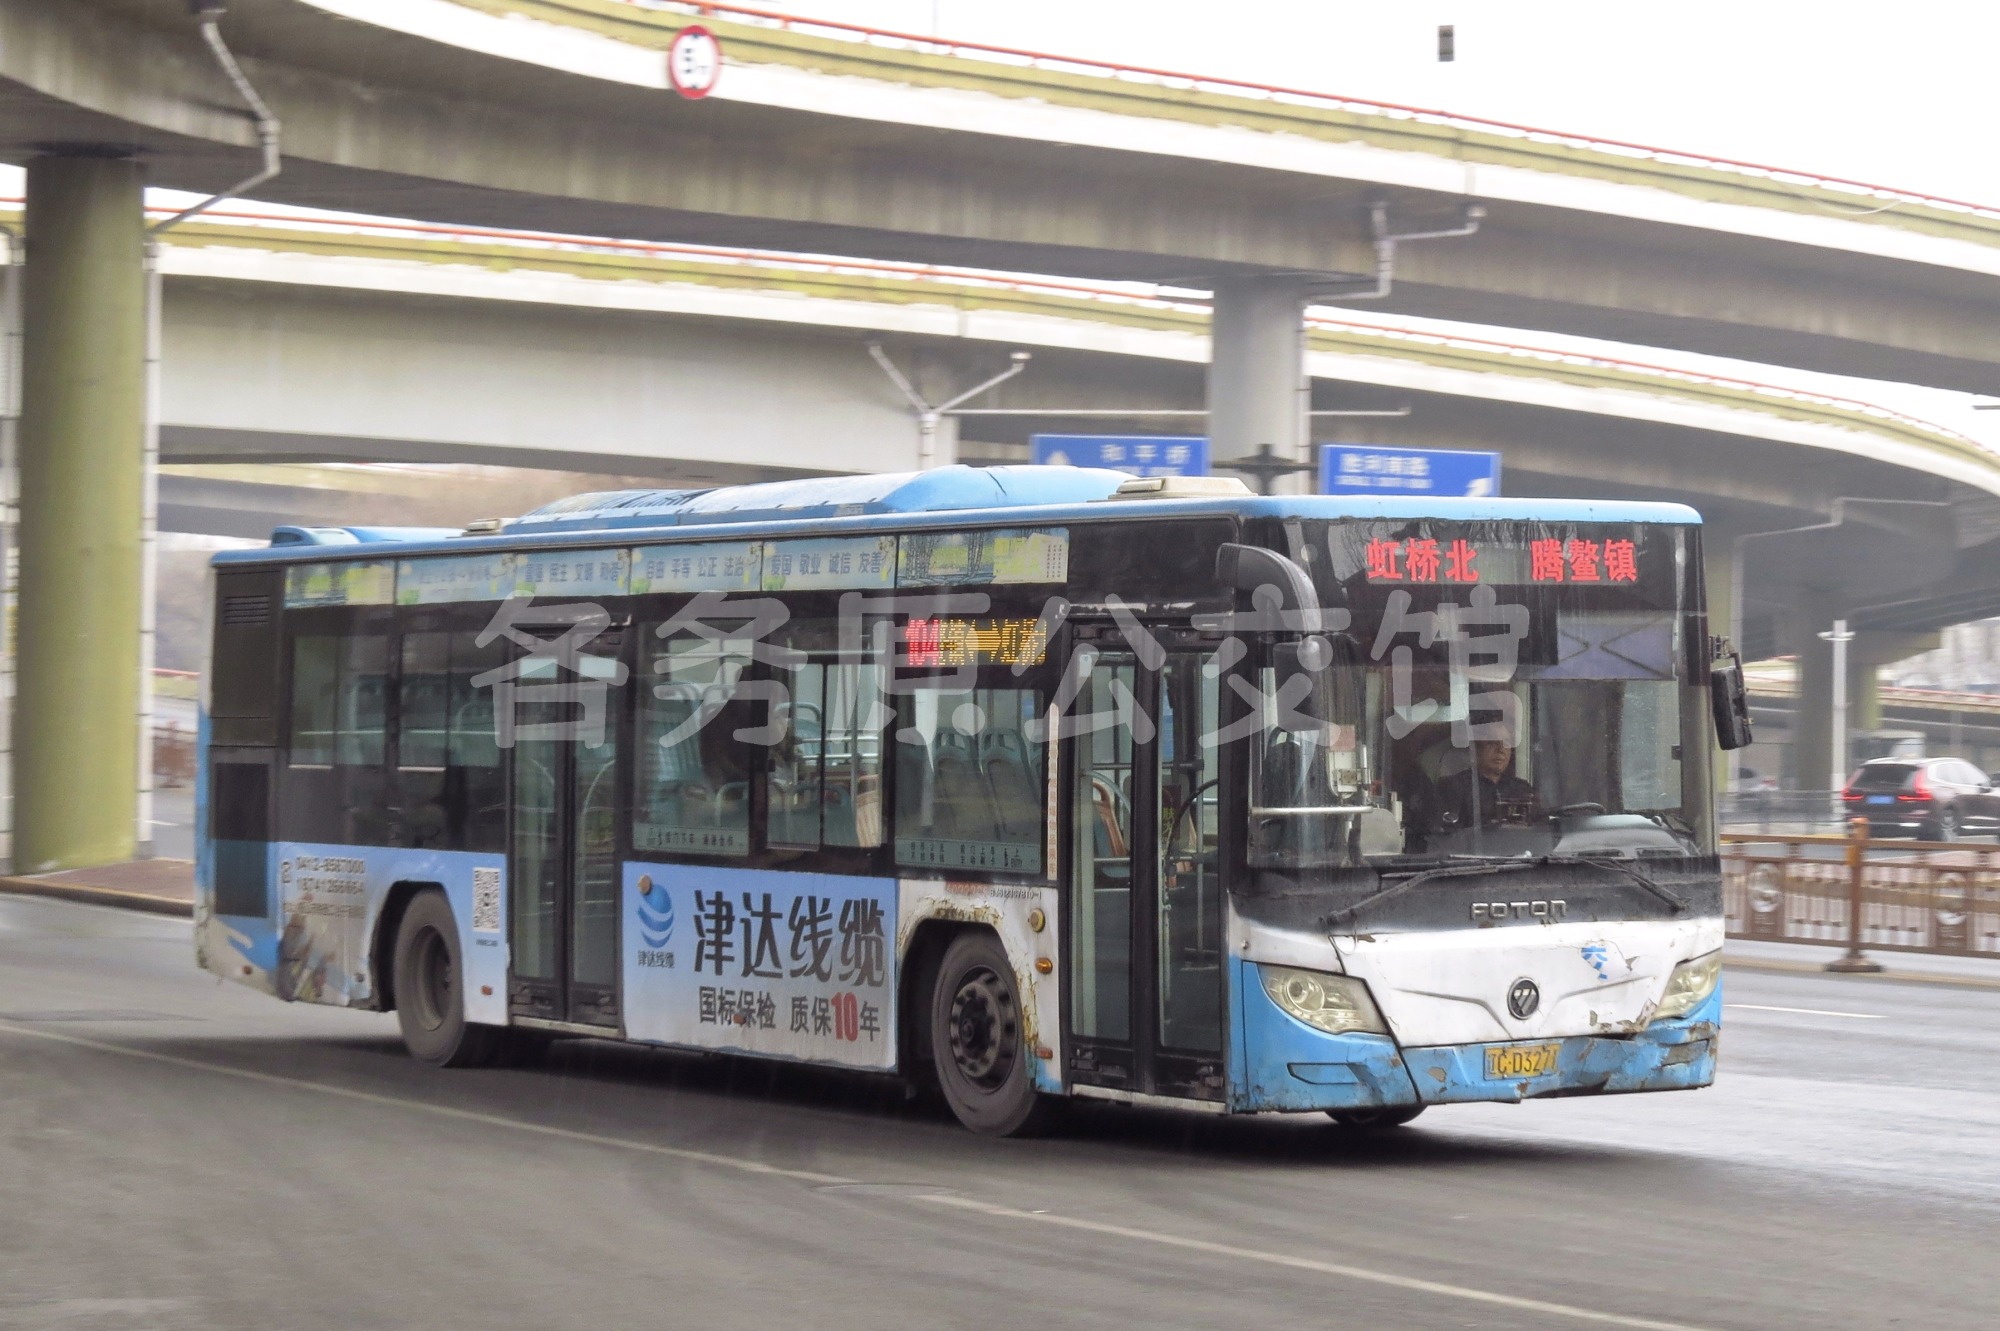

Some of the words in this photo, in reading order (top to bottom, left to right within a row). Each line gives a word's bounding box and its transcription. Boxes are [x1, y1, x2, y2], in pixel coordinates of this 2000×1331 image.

[1366, 537, 1479, 583] 虹桥北
[1530, 538, 1638, 583] 腾鳌镇
[1471, 900, 1566, 920] FOTON
[693, 889, 886, 988] 津达线缆
[699, 985, 777, 1031] 国标保检
[789, 991, 881, 1043] 质保10年
